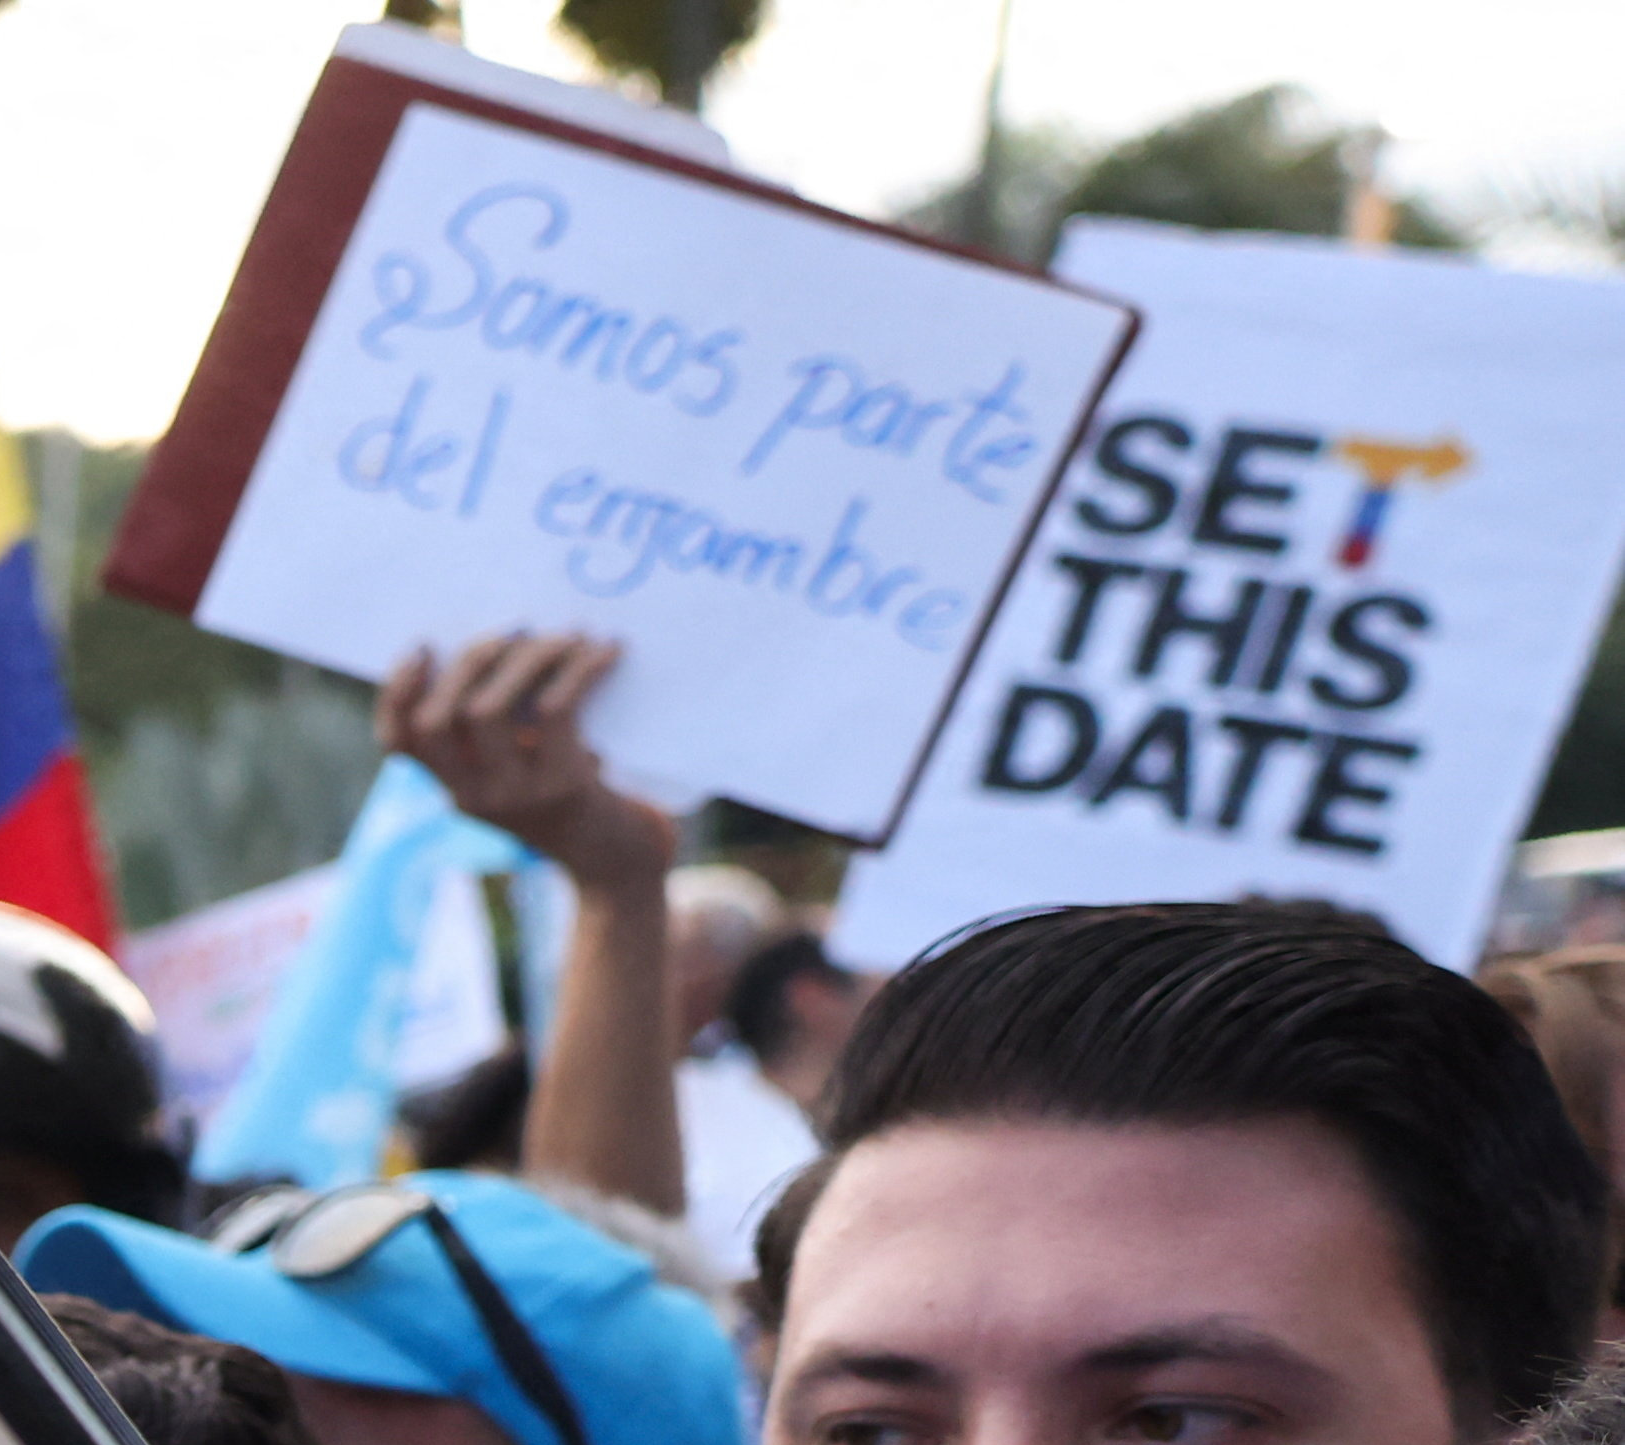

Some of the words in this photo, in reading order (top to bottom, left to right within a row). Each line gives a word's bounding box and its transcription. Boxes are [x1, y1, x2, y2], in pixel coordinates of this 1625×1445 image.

[358, 181, 747, 418] Somos
[738, 352, 1037, 505] parte
[336, 371, 518, 520] del
[1073, 416, 1475, 572] SET
[1055, 553, 1433, 712] THIS
[979, 683, 1423, 857] DATE
